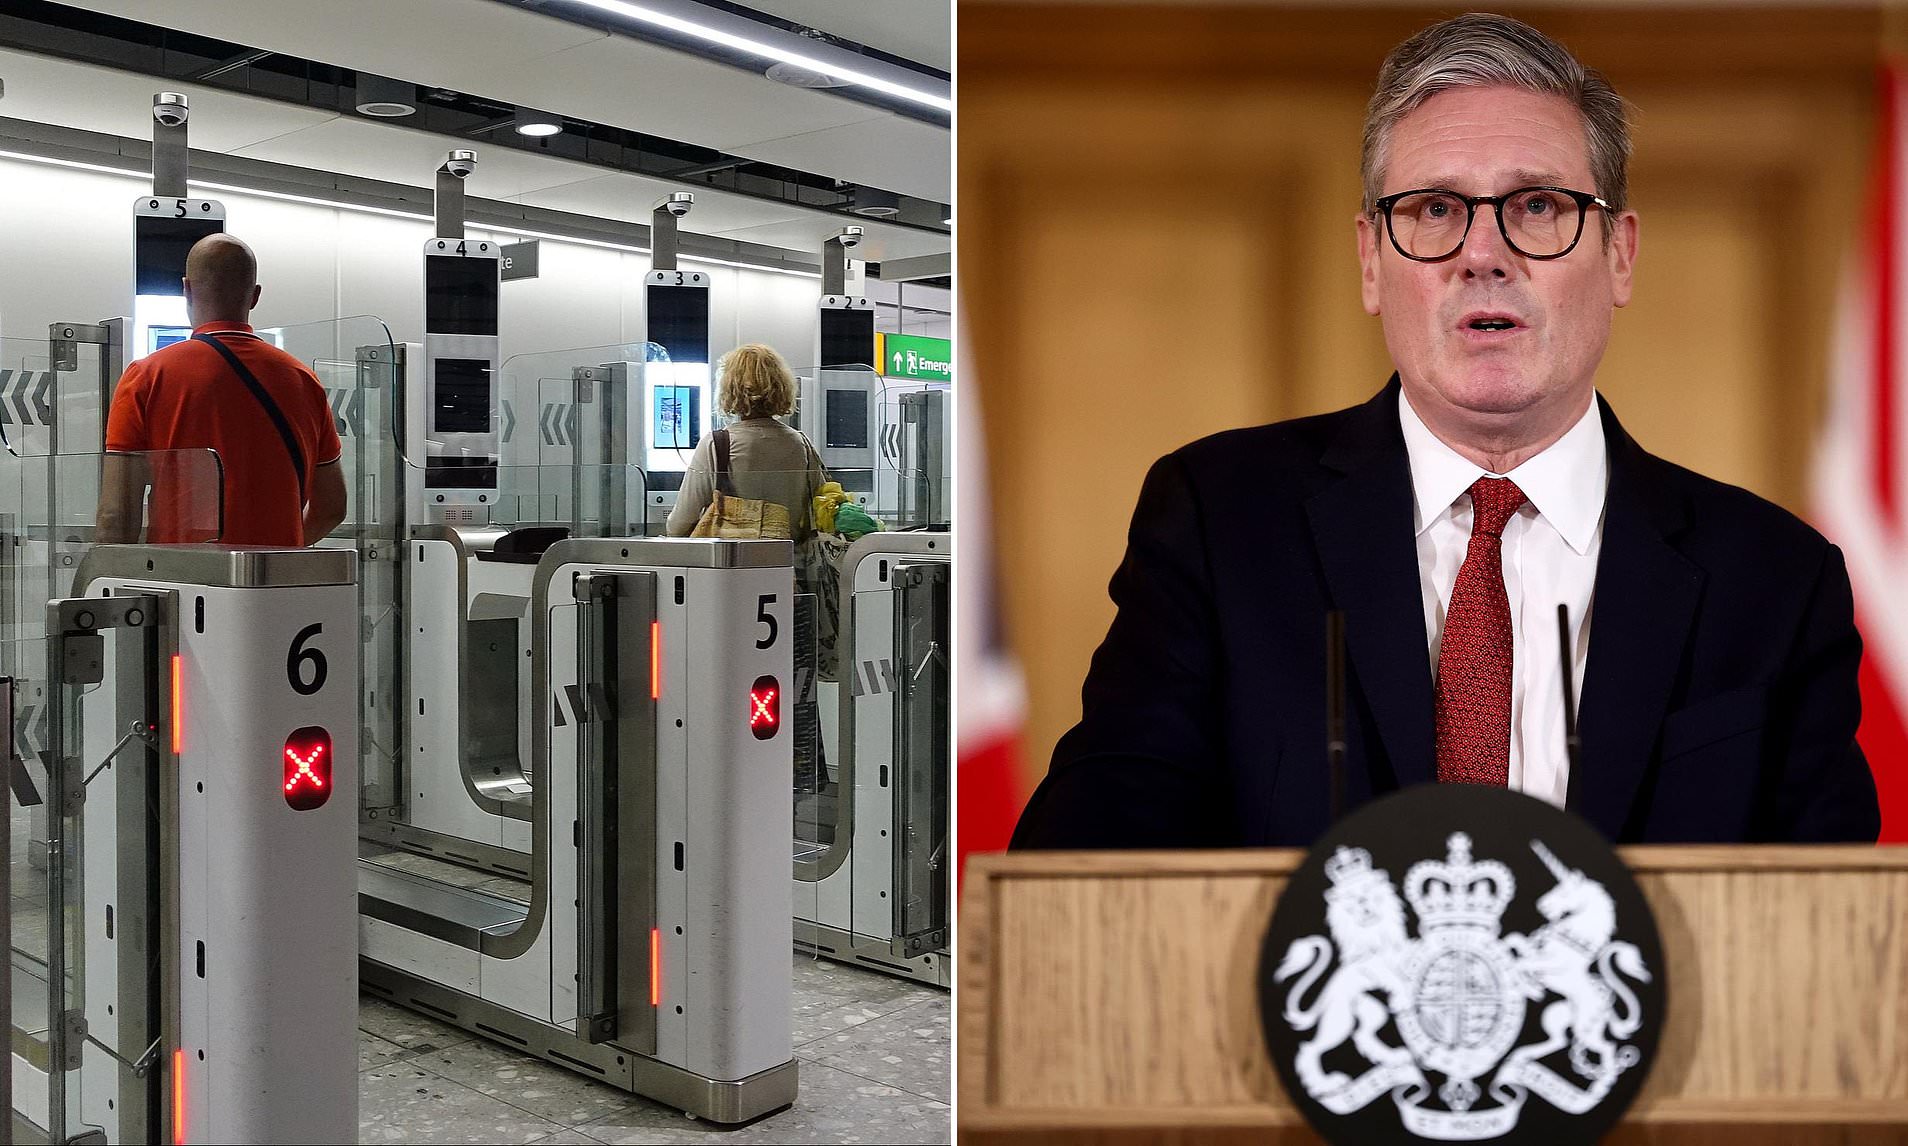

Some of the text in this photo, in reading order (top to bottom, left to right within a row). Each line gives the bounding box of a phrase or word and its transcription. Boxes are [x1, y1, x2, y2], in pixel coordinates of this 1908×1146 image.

[175, 199, 187, 218] 5
[456, 241, 468, 257] 4
[674, 271, 684, 286] 3
[844, 295, 853, 308] 2
[755, 593, 779, 650] 5
[286, 622, 329, 696] 6
